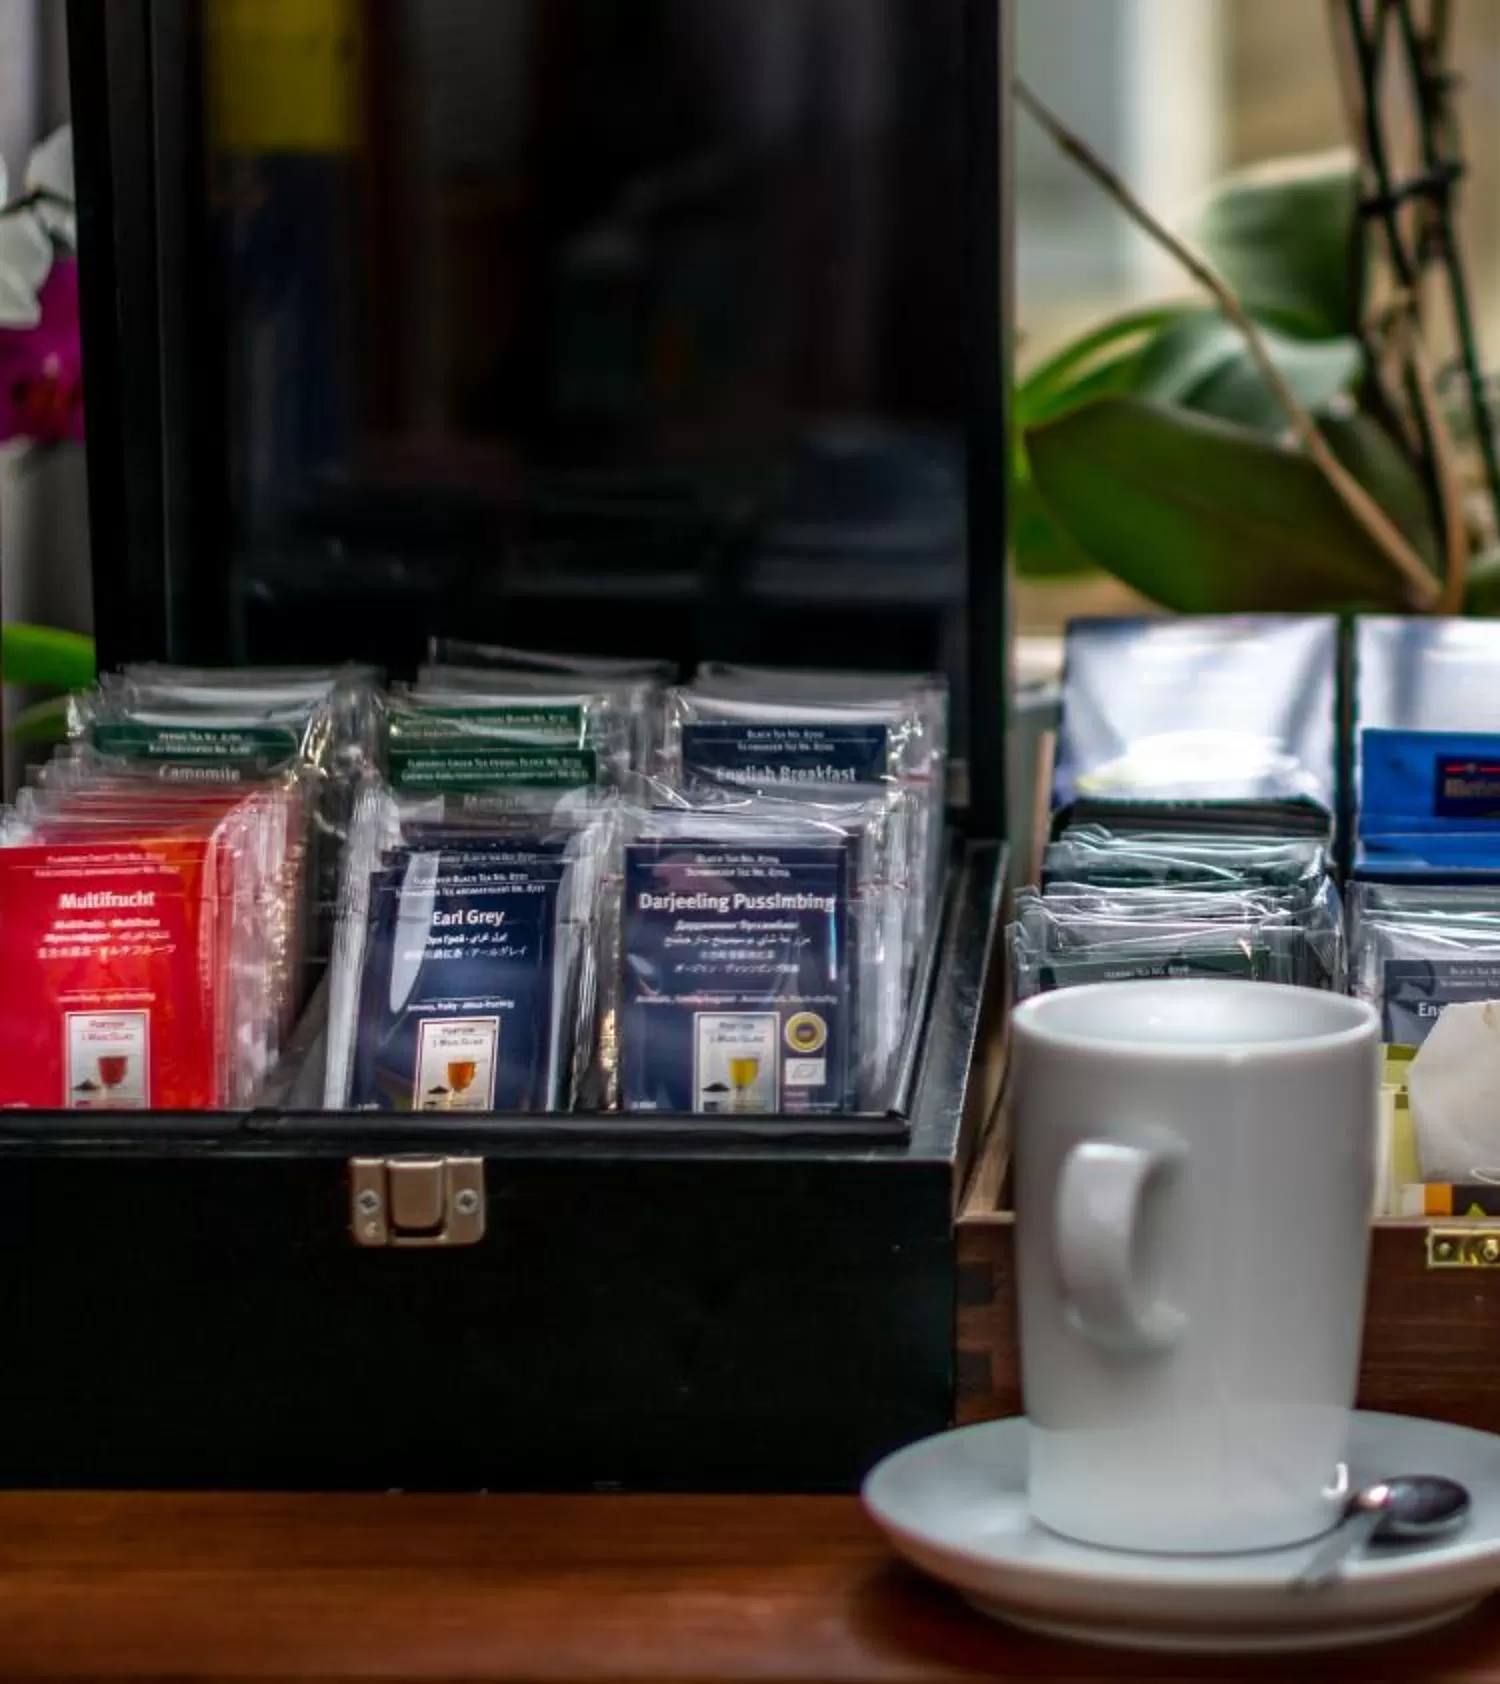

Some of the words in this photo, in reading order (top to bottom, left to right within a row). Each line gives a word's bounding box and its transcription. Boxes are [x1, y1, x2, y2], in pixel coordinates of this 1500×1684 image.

[159, 765, 241, 783] Camomile
[716, 764, 776, 784] English
[780, 764, 856, 784] Breakfast
[59, 891, 156, 909] Multifrucht
[639, 893, 729, 913] Darjeeling
[733, 893, 836, 913] Pussimbing
[433, 909, 463, 926] Earl
[466, 909, 505, 927] Grey
